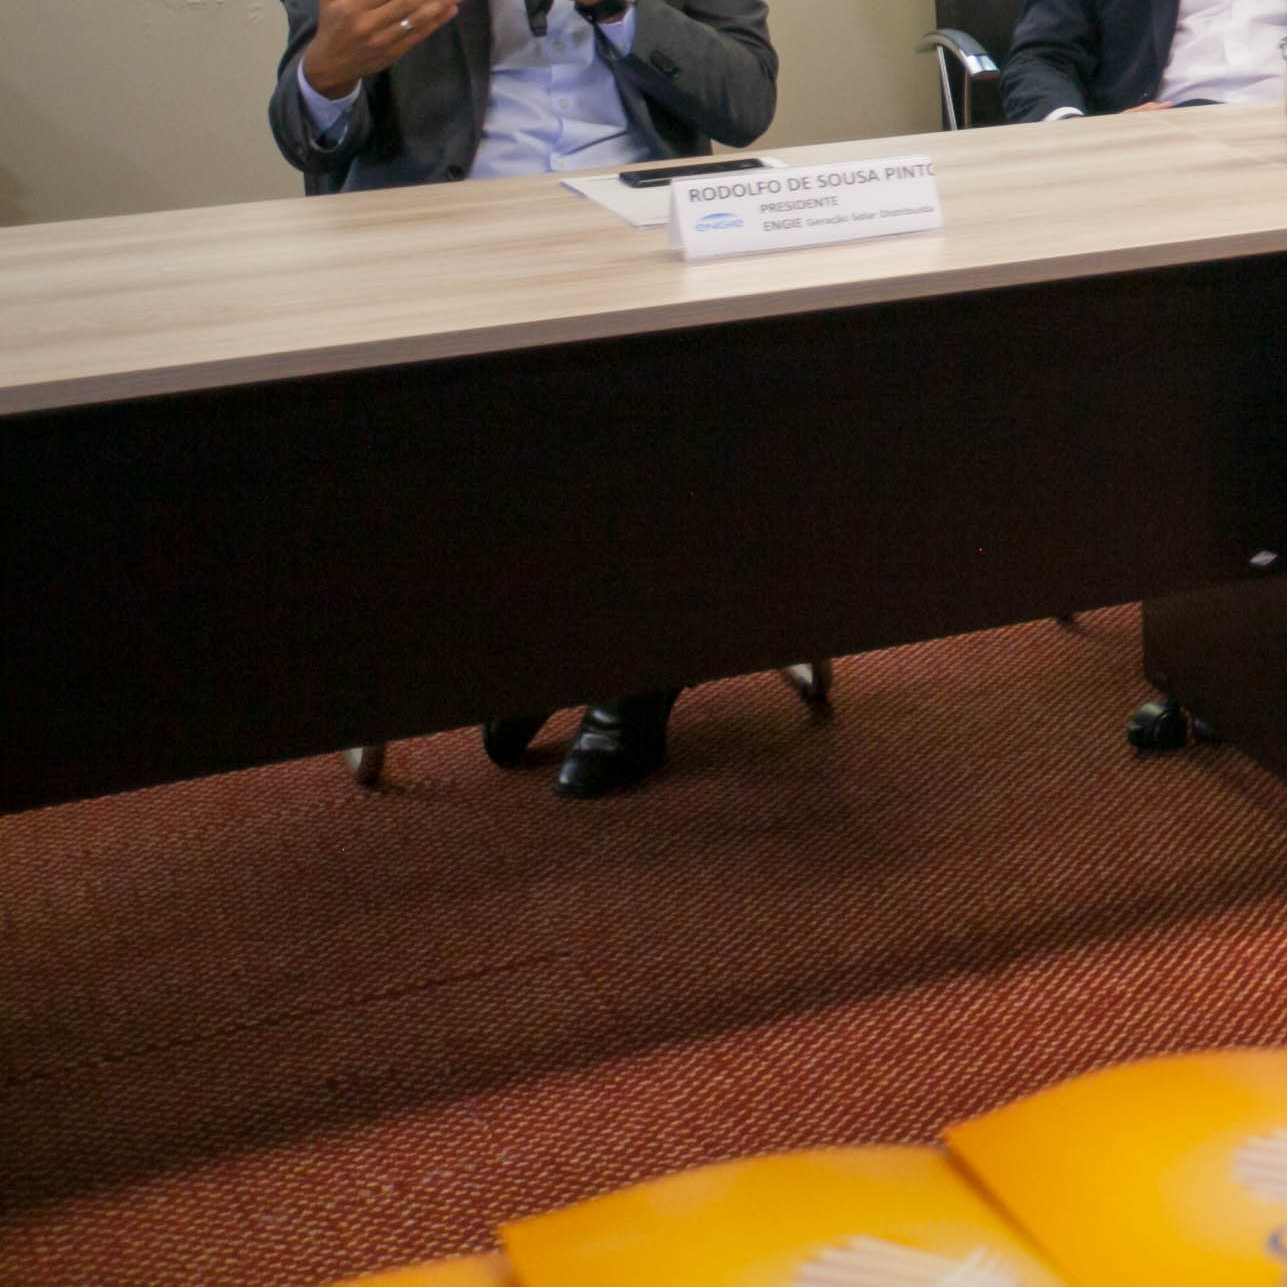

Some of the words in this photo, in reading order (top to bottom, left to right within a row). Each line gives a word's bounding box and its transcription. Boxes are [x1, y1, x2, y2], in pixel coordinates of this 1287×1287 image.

[689, 179, 782, 202] RODOLFO
[787, 176, 812, 191] DE
[817, 168, 881, 189] SOUSA
[760, 196, 839, 213] PRESIDENTE
[763, 218, 803, 231] ENGIE
